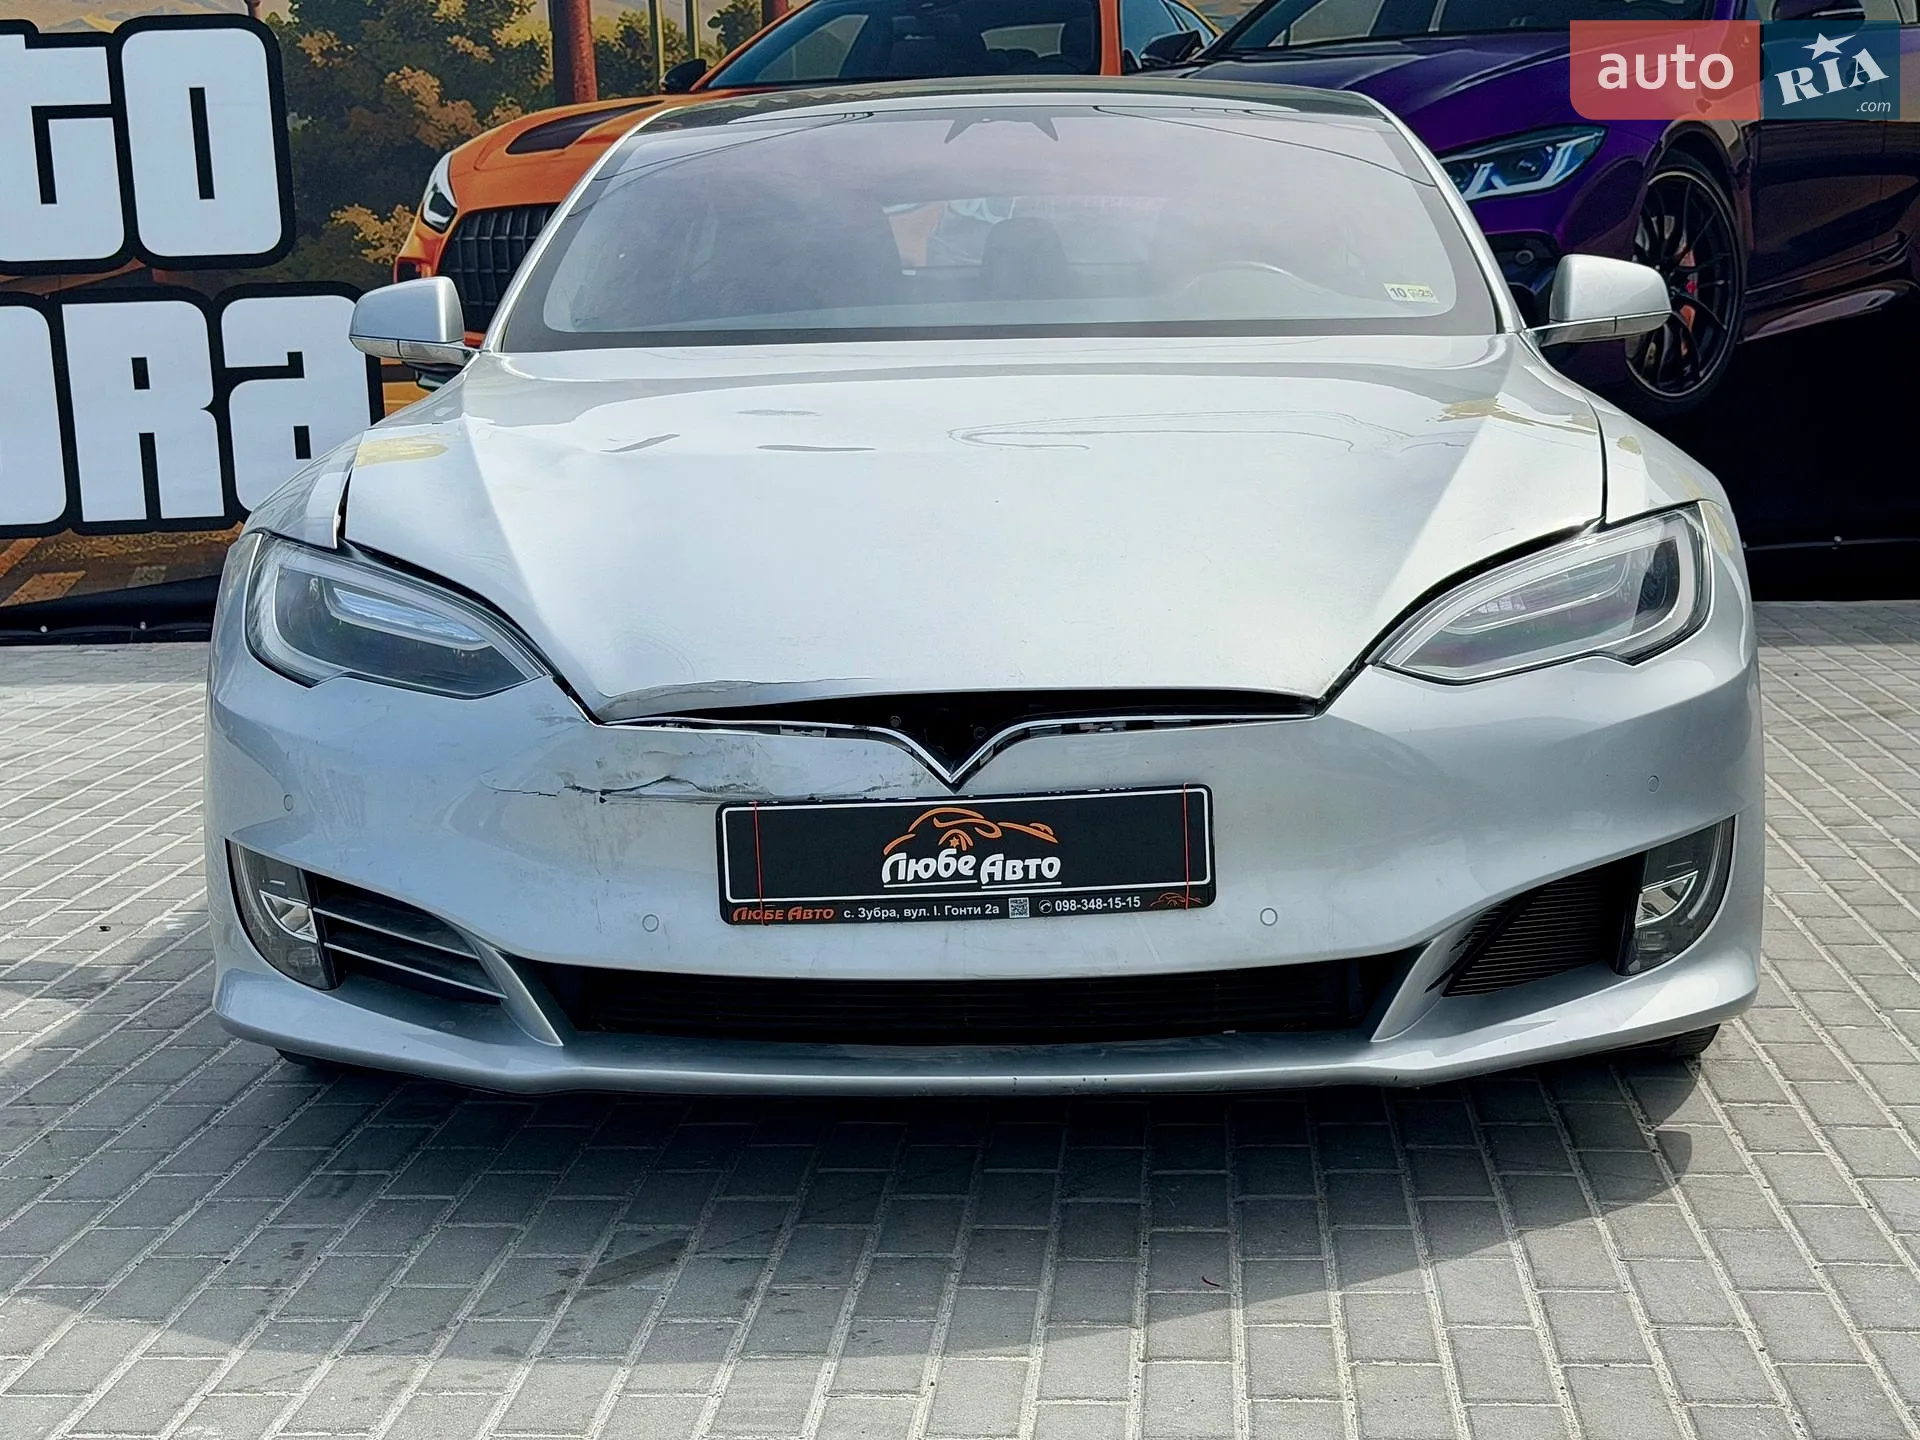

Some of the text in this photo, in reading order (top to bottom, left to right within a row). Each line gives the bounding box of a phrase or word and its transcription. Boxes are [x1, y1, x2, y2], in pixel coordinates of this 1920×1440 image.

[1390, 287, 1407, 298] 10
[881, 848, 1061, 885] Любе Авто
[857, 906, 901, 920] Зубра,
[903, 908, 930, 919] вул.
[944, 904, 982, 917] Гонти
[984, 903, 1000, 915] 2а
[1055, 896, 1141, 912] 098-348-15-15
